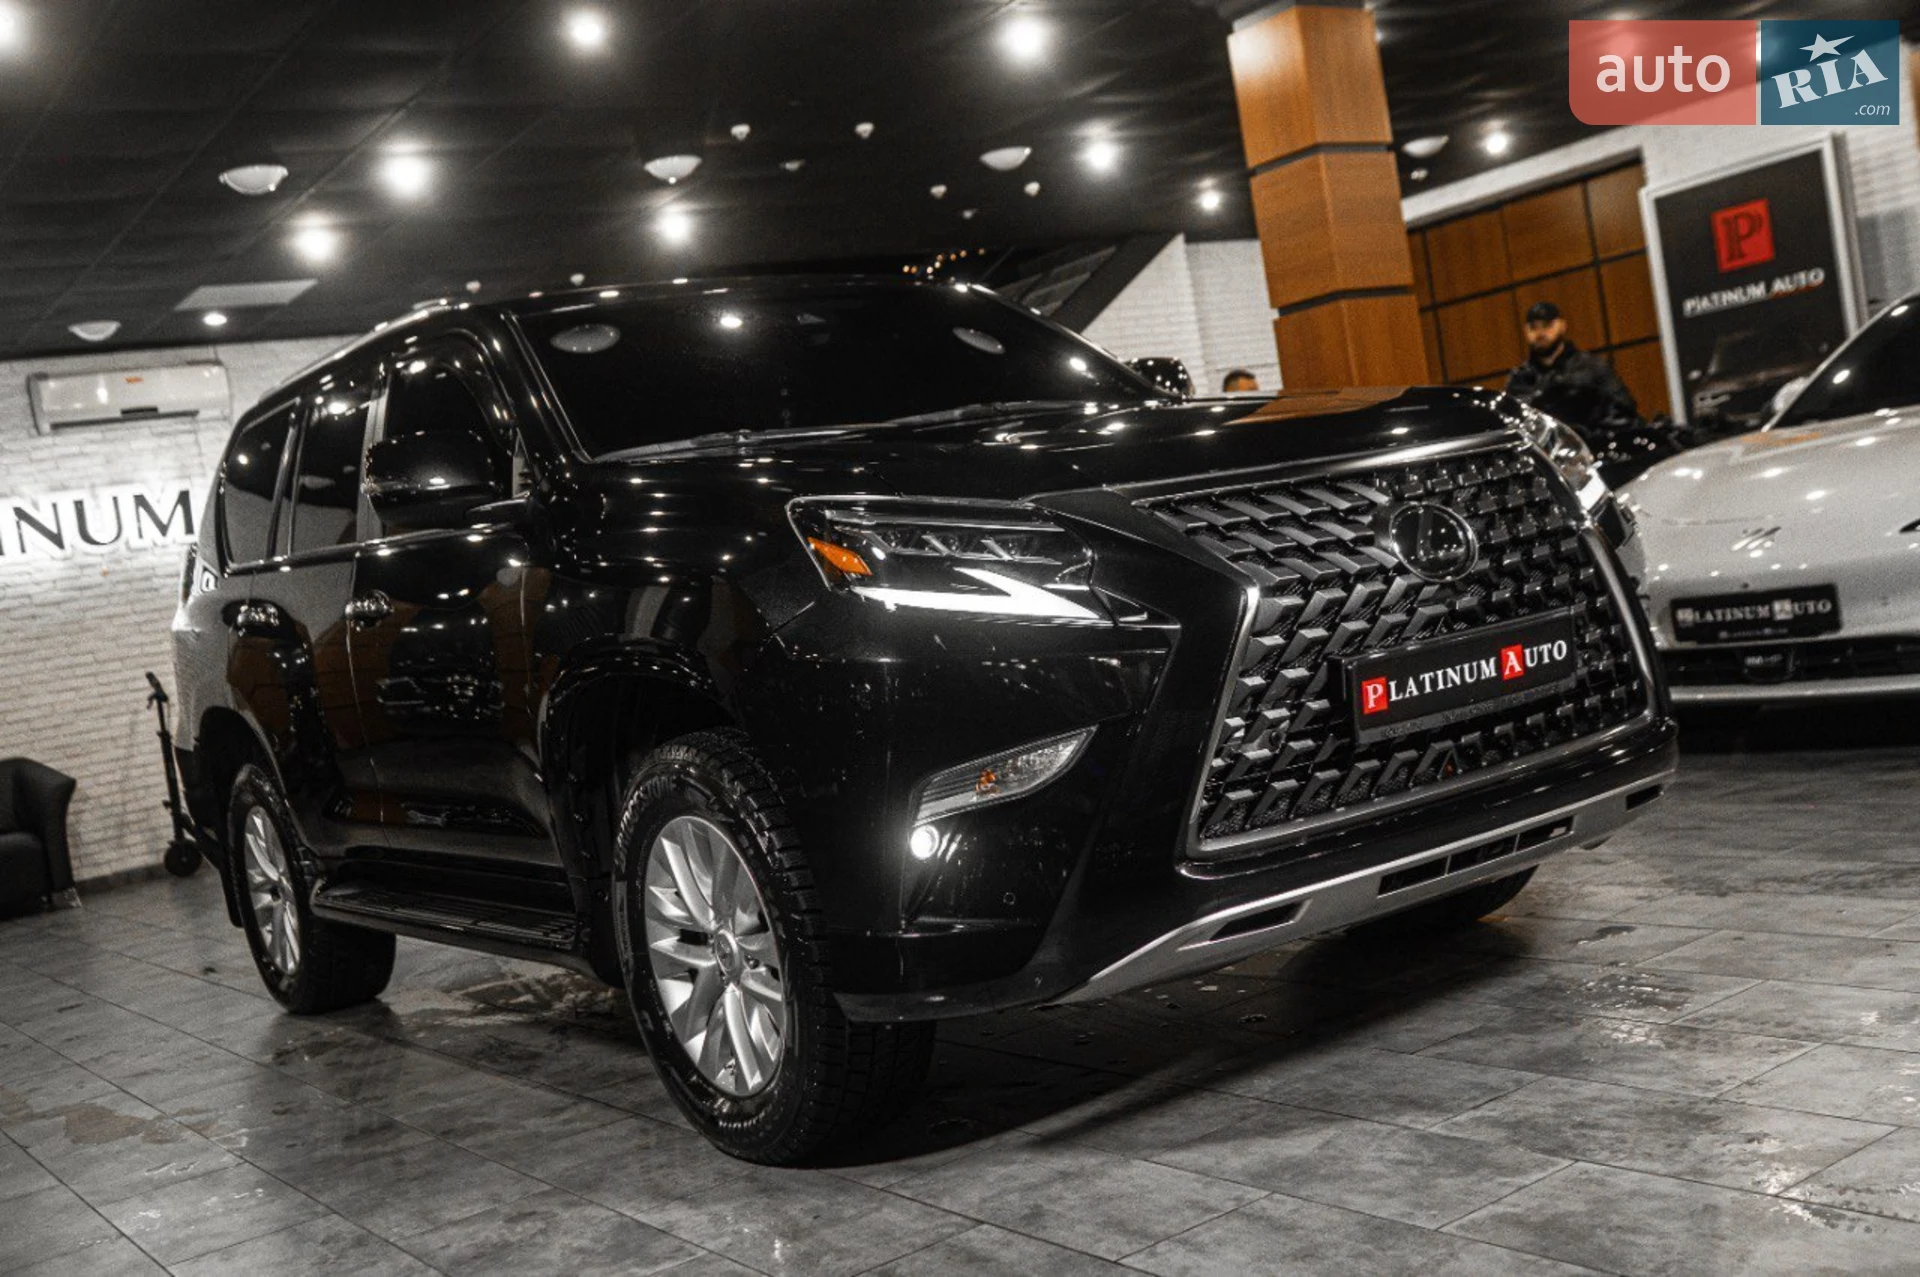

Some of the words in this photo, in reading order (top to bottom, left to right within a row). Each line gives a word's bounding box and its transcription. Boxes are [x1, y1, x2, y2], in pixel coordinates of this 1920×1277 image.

[1721, 211, 1763, 262] P
[1682, 281, 1767, 318] PLATINUM
[1769, 267, 1826, 296] AUTO
[1364, 656, 1498, 711] PLATINUM
[1502, 640, 1568, 677] AUTO
